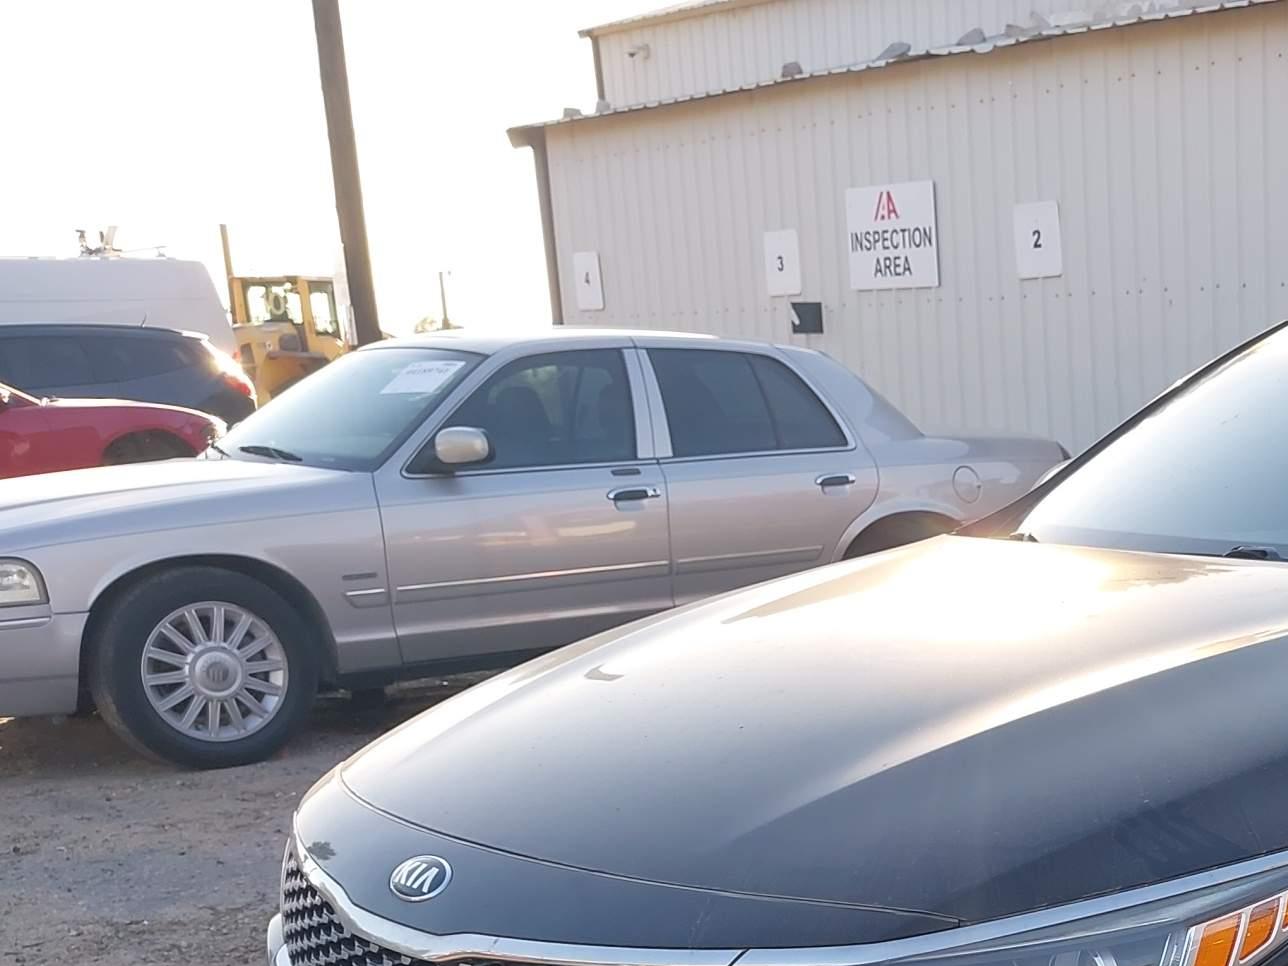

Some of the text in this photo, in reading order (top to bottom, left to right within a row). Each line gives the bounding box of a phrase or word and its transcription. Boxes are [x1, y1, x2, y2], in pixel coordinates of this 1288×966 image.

[850, 226, 932, 252] INSPECTION
[1031, 229, 1042, 249] 2
[777, 255, 784, 272] 3
[874, 255, 912, 278] AREA
[583, 271, 591, 287] 4
